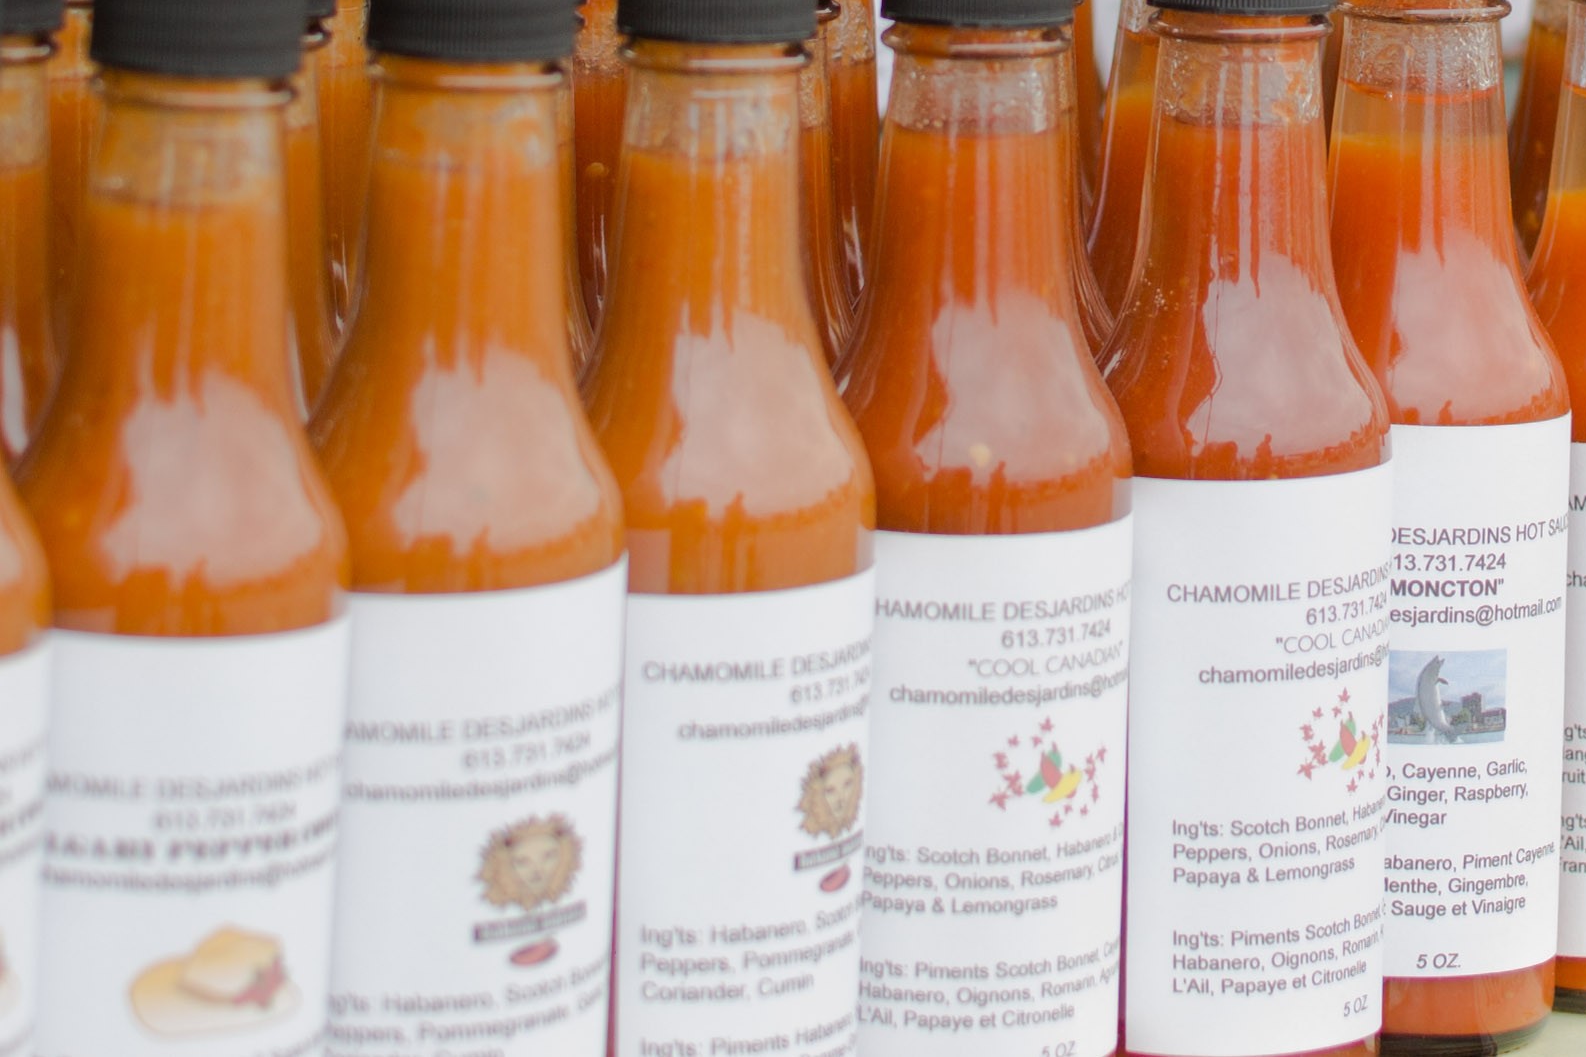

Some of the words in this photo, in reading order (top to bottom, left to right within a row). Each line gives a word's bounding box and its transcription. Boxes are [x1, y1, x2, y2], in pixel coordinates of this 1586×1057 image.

[1515, 520, 1547, 542] HOT
[1393, 552, 1507, 572] 13.731.7424
[1166, 582, 1302, 603] CHAMOMILE
[1390, 578, 1505, 598] MONCTON"
[874, 597, 996, 623] HAMOMILE
[1003, 589, 1114, 622] DESJARDINS
[1306, 590, 1388, 626] 613.731.7424
[1389, 595, 1563, 628] esjardins@hotmail.com
[1001, 618, 1111, 649] 613.731.7424
[1275, 632, 1337, 654] "COOL
[641, 657, 786, 683] CHAMOMILE
[1402, 762, 1481, 783] Cayenne,
[1486, 758, 1528, 778] Garlic,
[1562, 770, 1586, 784] ruit
[1386, 785, 1448, 805] Ginger,
[1454, 781, 1529, 804] Raspberry,
[1171, 819, 1224, 840] Ing'ts:
[1230, 818, 1290, 837] Scotch
[1295, 810, 1349, 833] Bonnet,
[917, 846, 980, 866] Scotch
[986, 846, 1051, 865] Bonnet,
[1173, 843, 1252, 864] Peppers,
[1258, 841, 1321, 860] Onions,
[1384, 854, 1457, 873] abanero,
[1462, 852, 1513, 870] Piment
[1516, 841, 1556, 864] Cayenne
[863, 866, 938, 890] Peppers,
[945, 871, 1015, 891] Onions,
[1173, 867, 1241, 888] Papaya
[1247, 867, 1259, 883] &
[1265, 857, 1356, 883] Lemongrass
[1448, 872, 1529, 895] Gingembre,
[860, 890, 925, 916] Papaya
[932, 897, 945, 914] &
[951, 893, 1058, 916] Lemongrass
[1391, 900, 1447, 920] Sauge
[1451, 901, 1467, 916] et
[1471, 895, 1526, 915] Vinaigre
[1172, 930, 1224, 950] Ing'ts:
[1231, 928, 1300, 947] Piments
[1305, 918, 1351, 941] Scotch
[914, 960, 990, 980] Piments
[995, 958, 1052, 979] Scotch
[1172, 953, 1265, 973] Habanero,
[1271, 945, 1338, 970] Oignons,
[1415, 953, 1428, 970] 5
[1432, 952, 1461, 969] OZ.
[757, 972, 814, 996] Cumin
[1172, 976, 1214, 996] L'Ail,
[1221, 975, 1287, 997] Papaye
[1292, 973, 1307, 989] et
[1311, 960, 1368, 987] Citronelle
[858, 980, 950, 1005] Habanero,
[956, 986, 1035, 1007] Oignons,
[1343, 1001, 1351, 1018] 5
[1353, 994, 1369, 1015] OZ
[903, 1009, 974, 1033] Papaye
[980, 1011, 997, 1029] et
[1002, 1002, 1075, 1027] Citronelle
